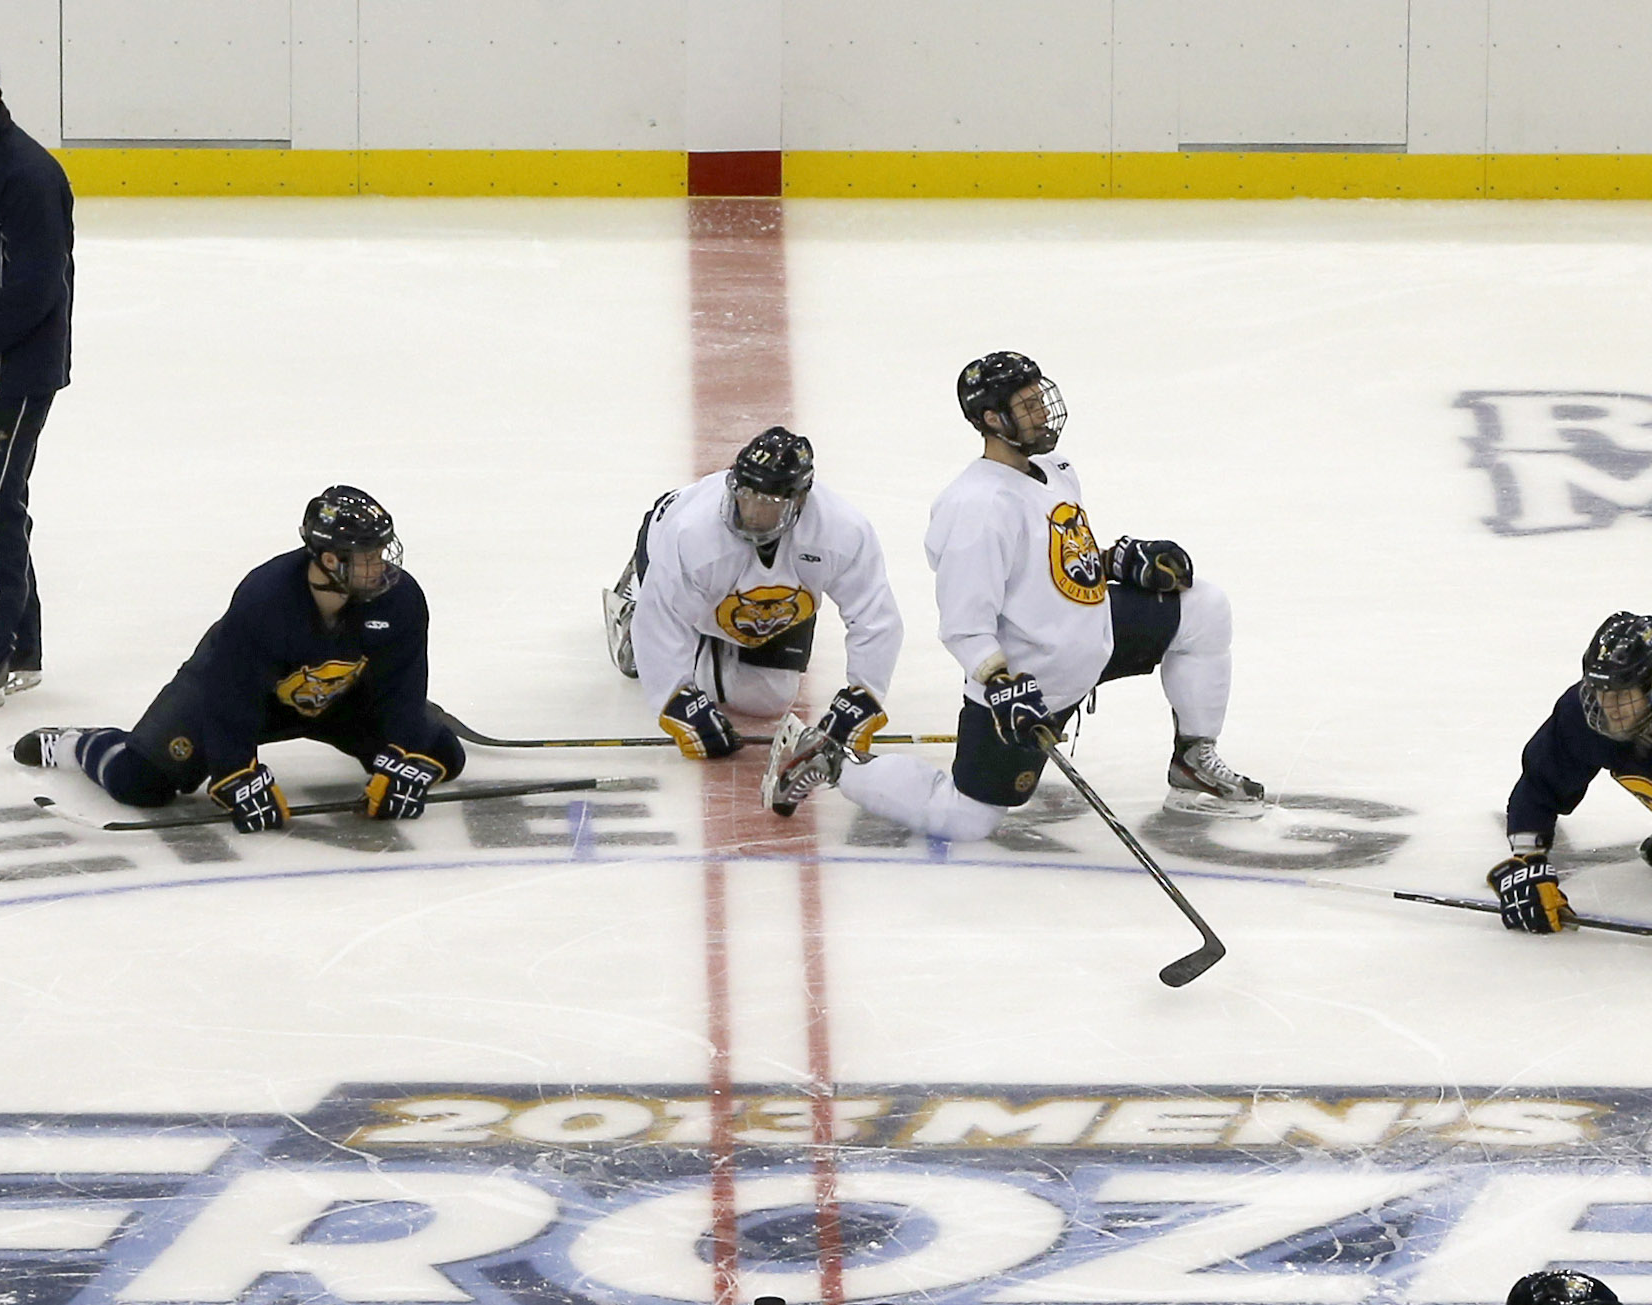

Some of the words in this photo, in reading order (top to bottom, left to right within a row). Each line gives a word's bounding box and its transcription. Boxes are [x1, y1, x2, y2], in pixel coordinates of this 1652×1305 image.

[1112, 535, 1133, 579] BAU
[989, 679, 1038, 706] BAUE
[373, 752, 433, 786] AUER
[235, 770, 275, 804] BAU
[1500, 862, 1557, 892] BAUE
[362, 1099, 883, 1145] 2013
[912, 1098, 1602, 1146] MEN'S
